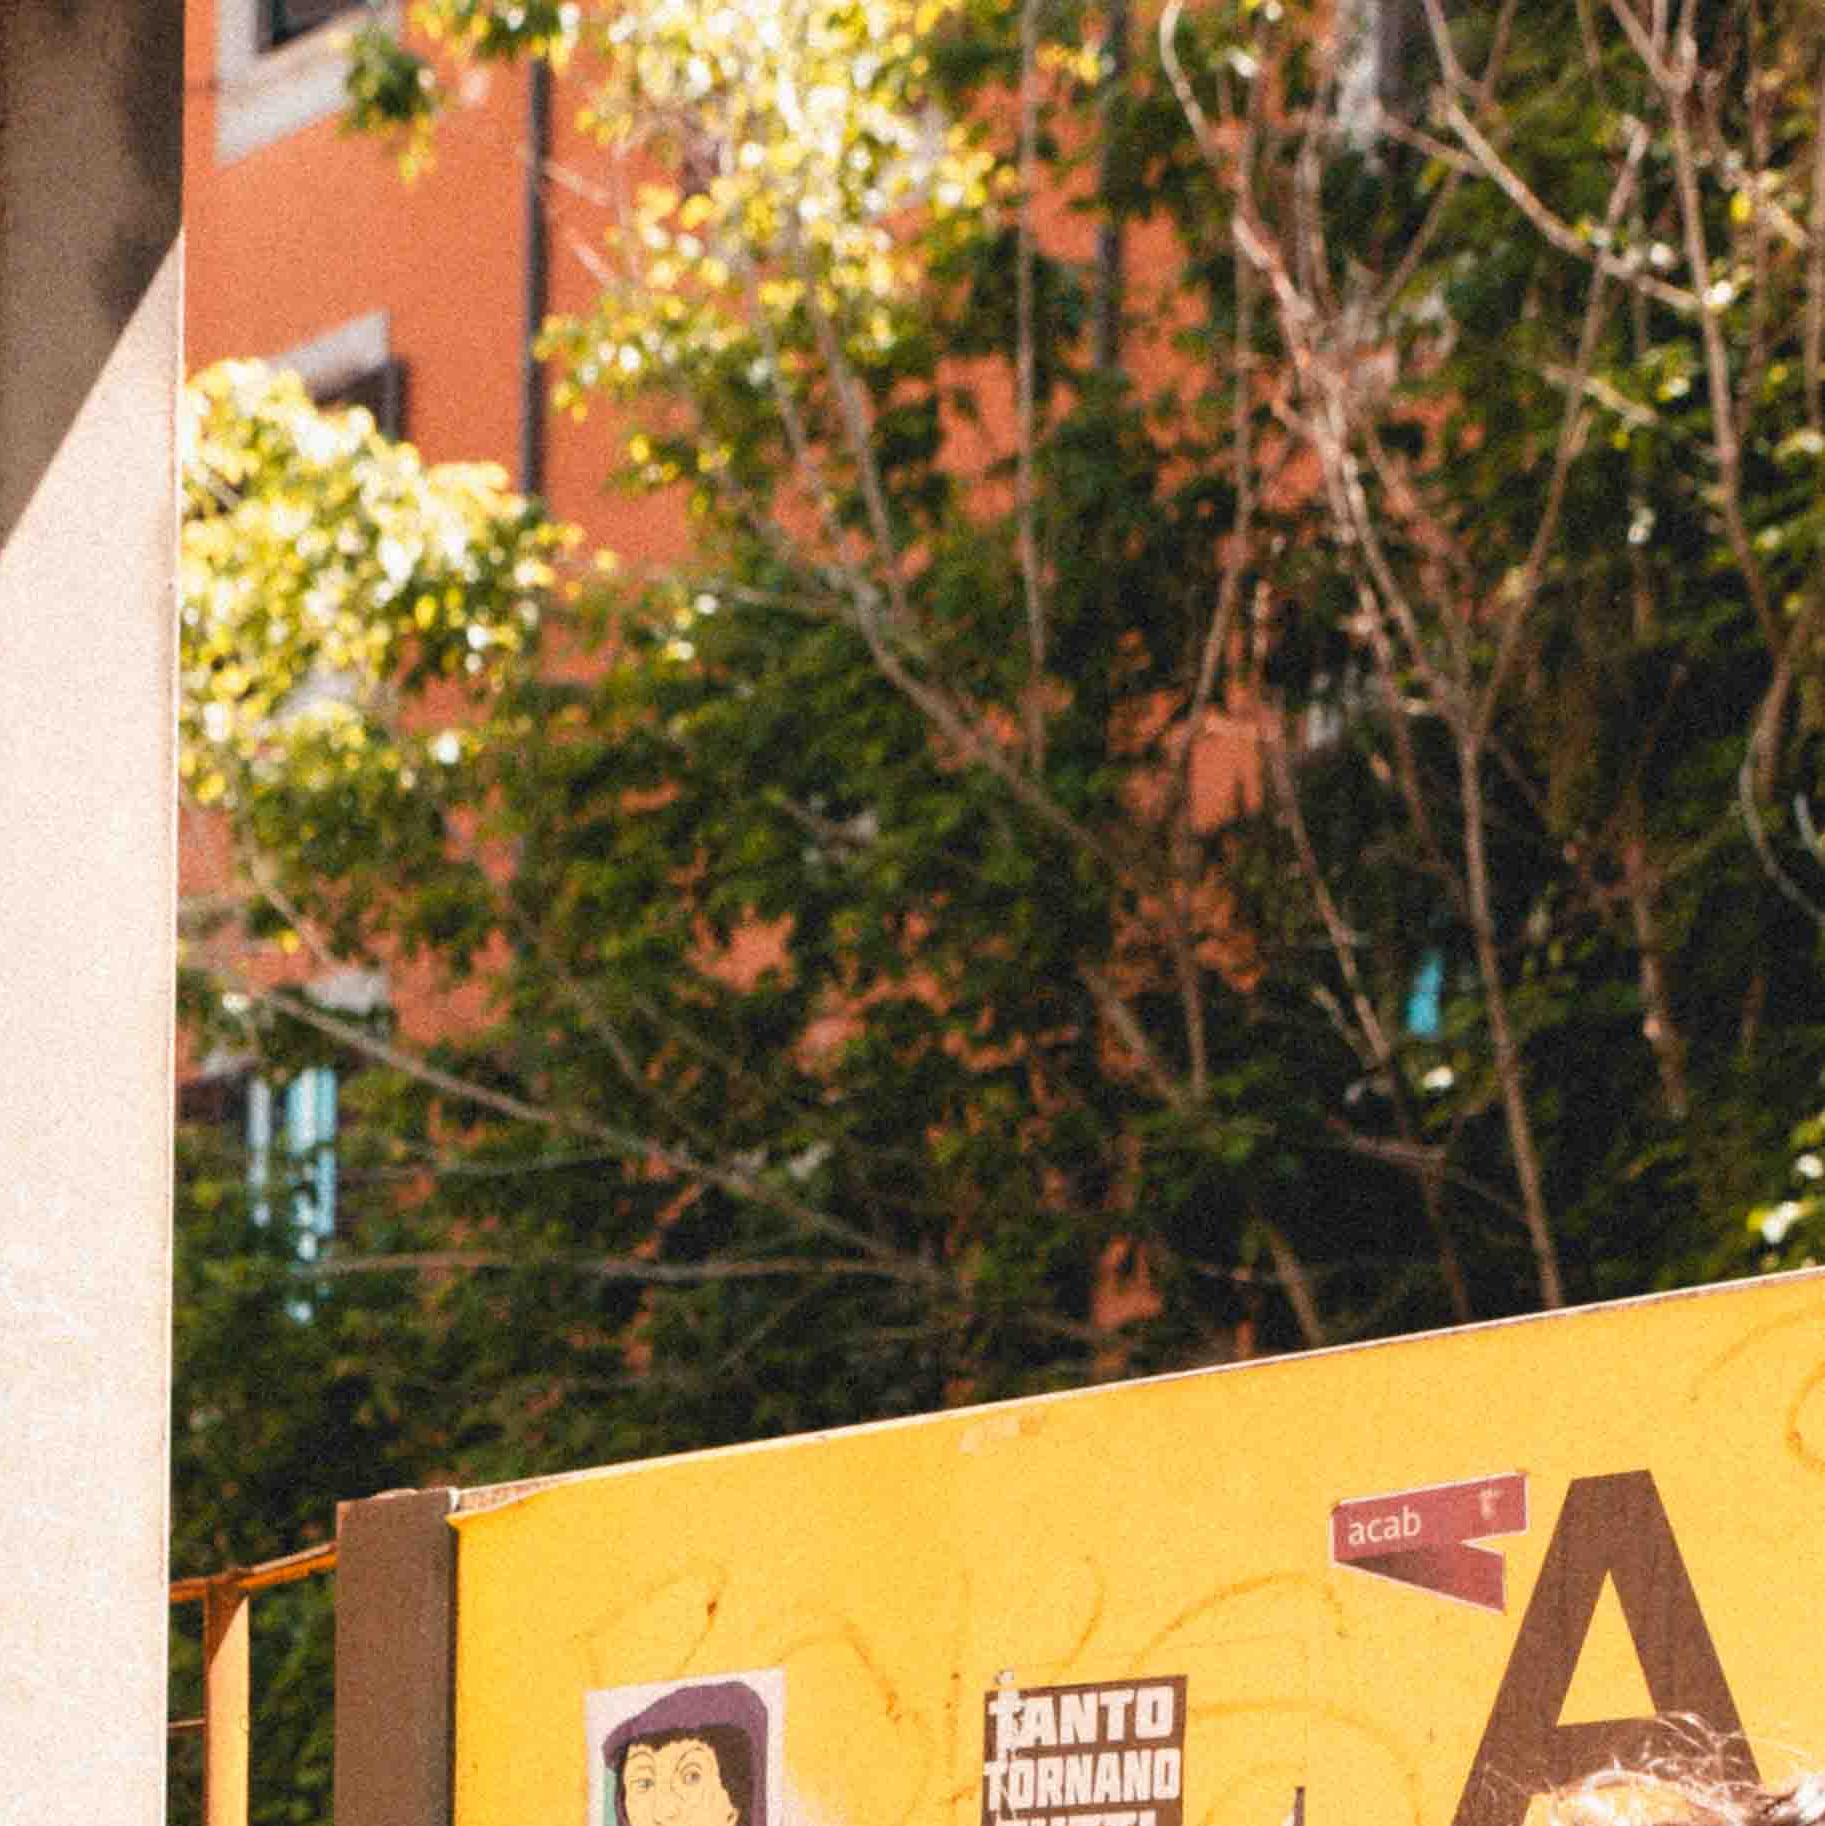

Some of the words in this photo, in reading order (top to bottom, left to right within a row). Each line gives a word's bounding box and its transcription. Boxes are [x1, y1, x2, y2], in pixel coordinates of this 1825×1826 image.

[1348, 1505, 1422, 1546] acab
[989, 1685, 1175, 1752] TANTO
[984, 1747, 1182, 1811] TORNANO
